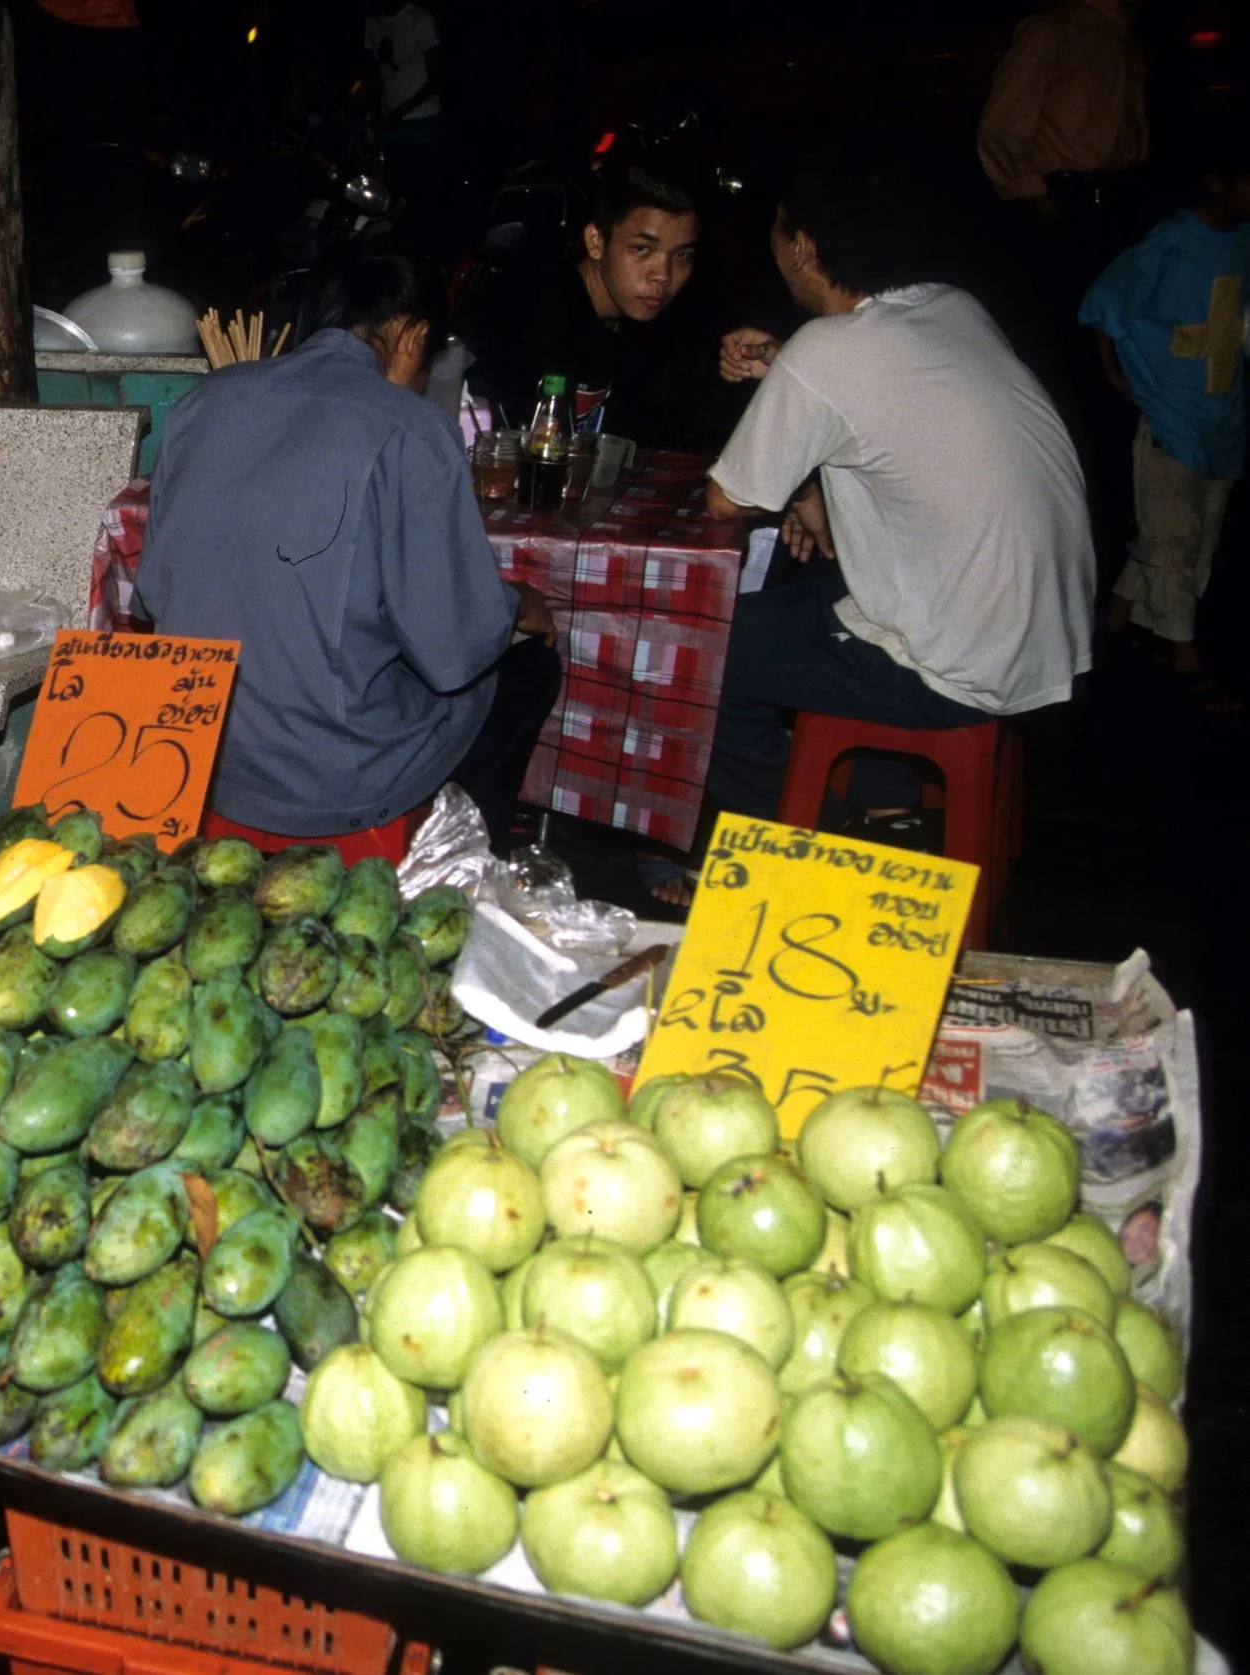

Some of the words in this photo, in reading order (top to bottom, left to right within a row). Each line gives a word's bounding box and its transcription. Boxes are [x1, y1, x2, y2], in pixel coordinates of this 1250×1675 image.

[46, 658, 85, 702] โล
[41, 710, 194, 822] 25
[705, 847, 749, 890] โล
[715, 898, 860, 1002] 18
